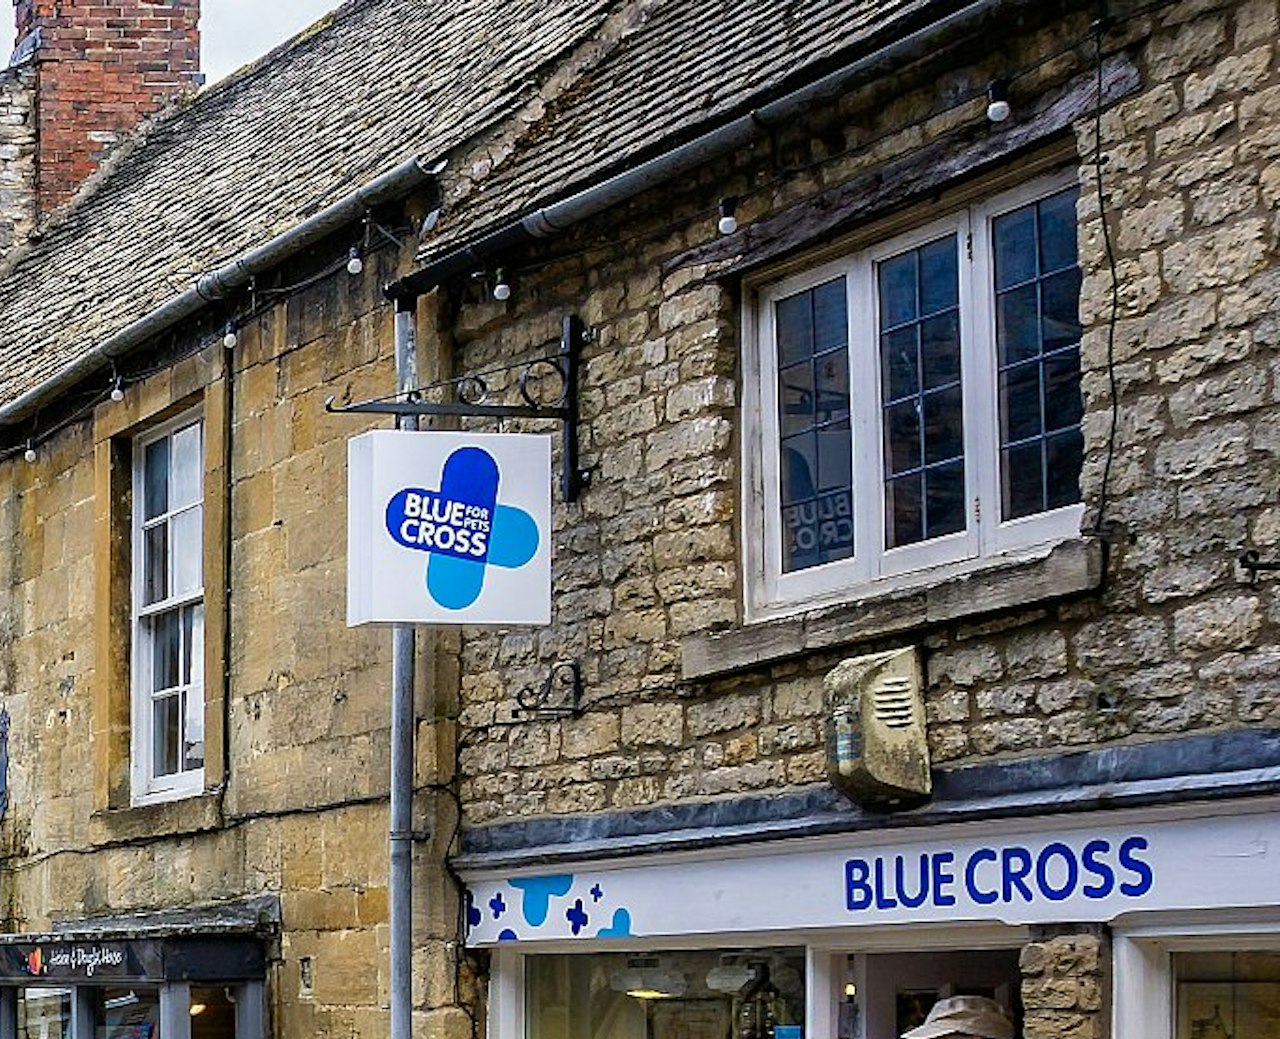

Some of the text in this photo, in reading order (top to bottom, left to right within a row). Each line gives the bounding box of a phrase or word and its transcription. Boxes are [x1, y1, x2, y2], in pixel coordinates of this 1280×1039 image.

[404, 493, 465, 526] BLUE
[464, 518, 490, 532] PETS
[465, 505, 489, 520] FOR
[401, 519, 486, 556] CROSS
[845, 837, 1154, 910] BLUE CROSS
